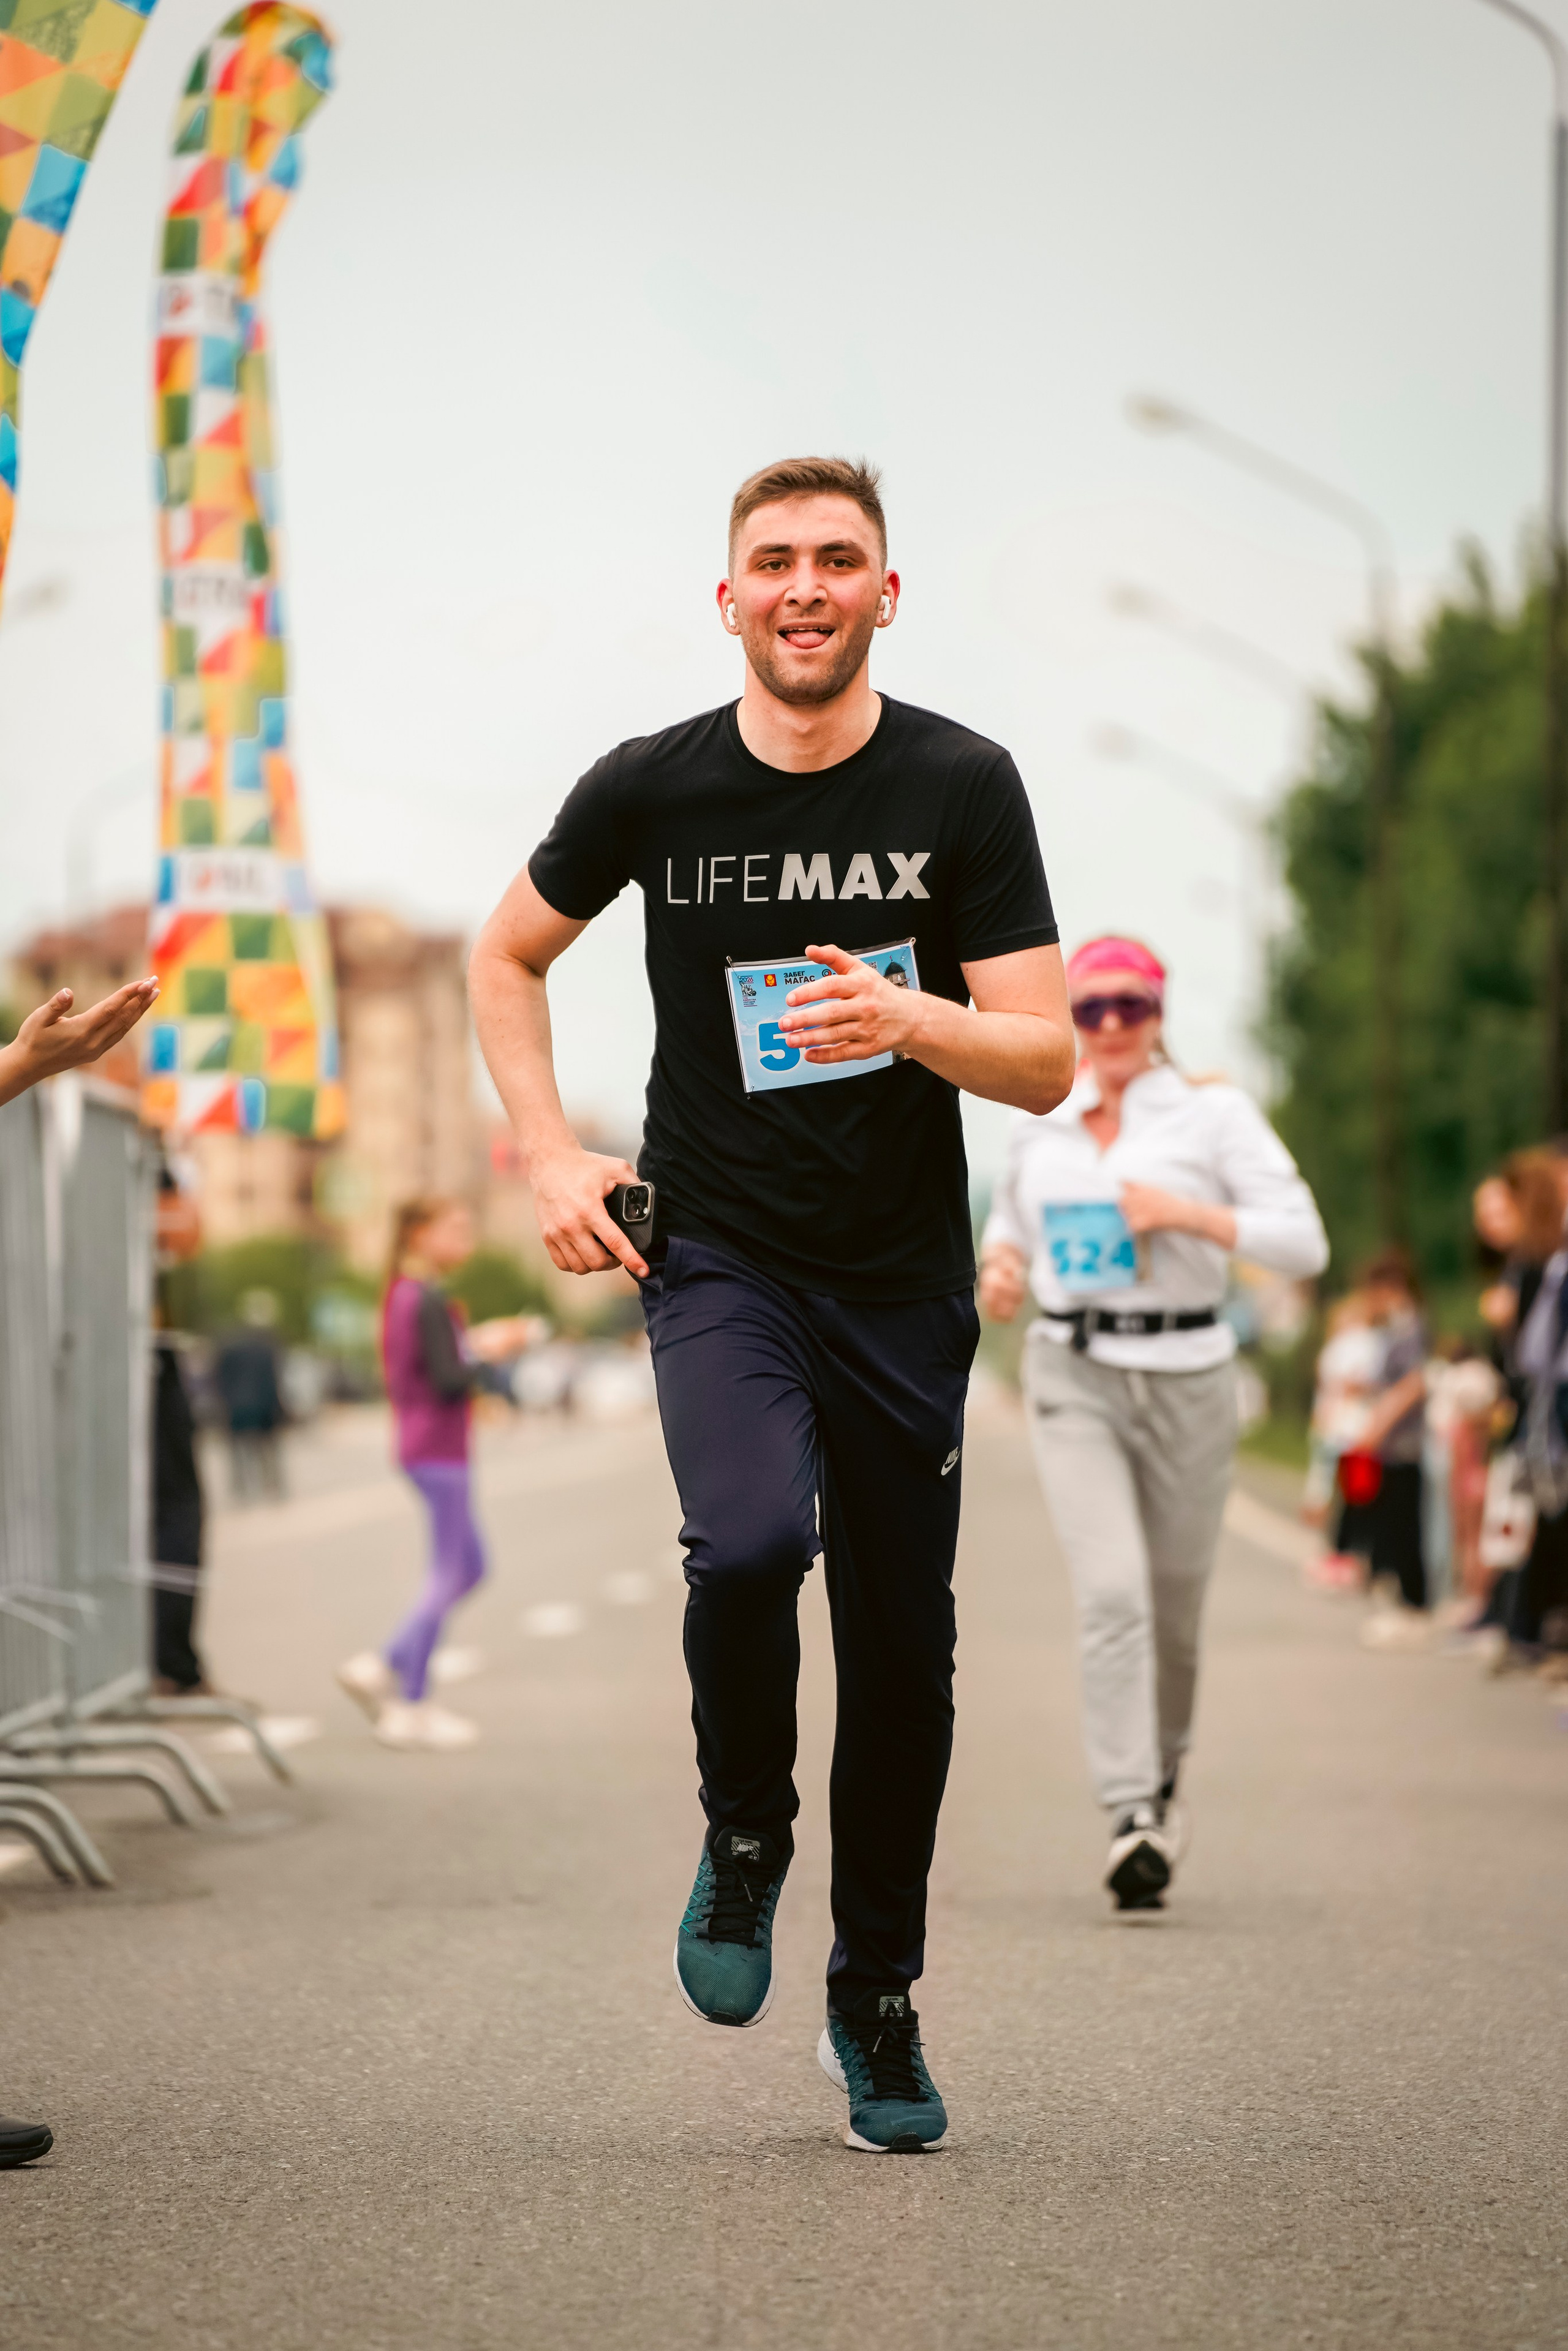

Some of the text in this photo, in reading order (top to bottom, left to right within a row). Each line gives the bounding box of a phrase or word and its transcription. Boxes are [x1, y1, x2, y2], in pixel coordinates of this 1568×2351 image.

[667, 852, 931, 904] LIFEMAX
[785, 975, 816, 985] МАГАС
[1052, 1239, 1134, 1275] 524
